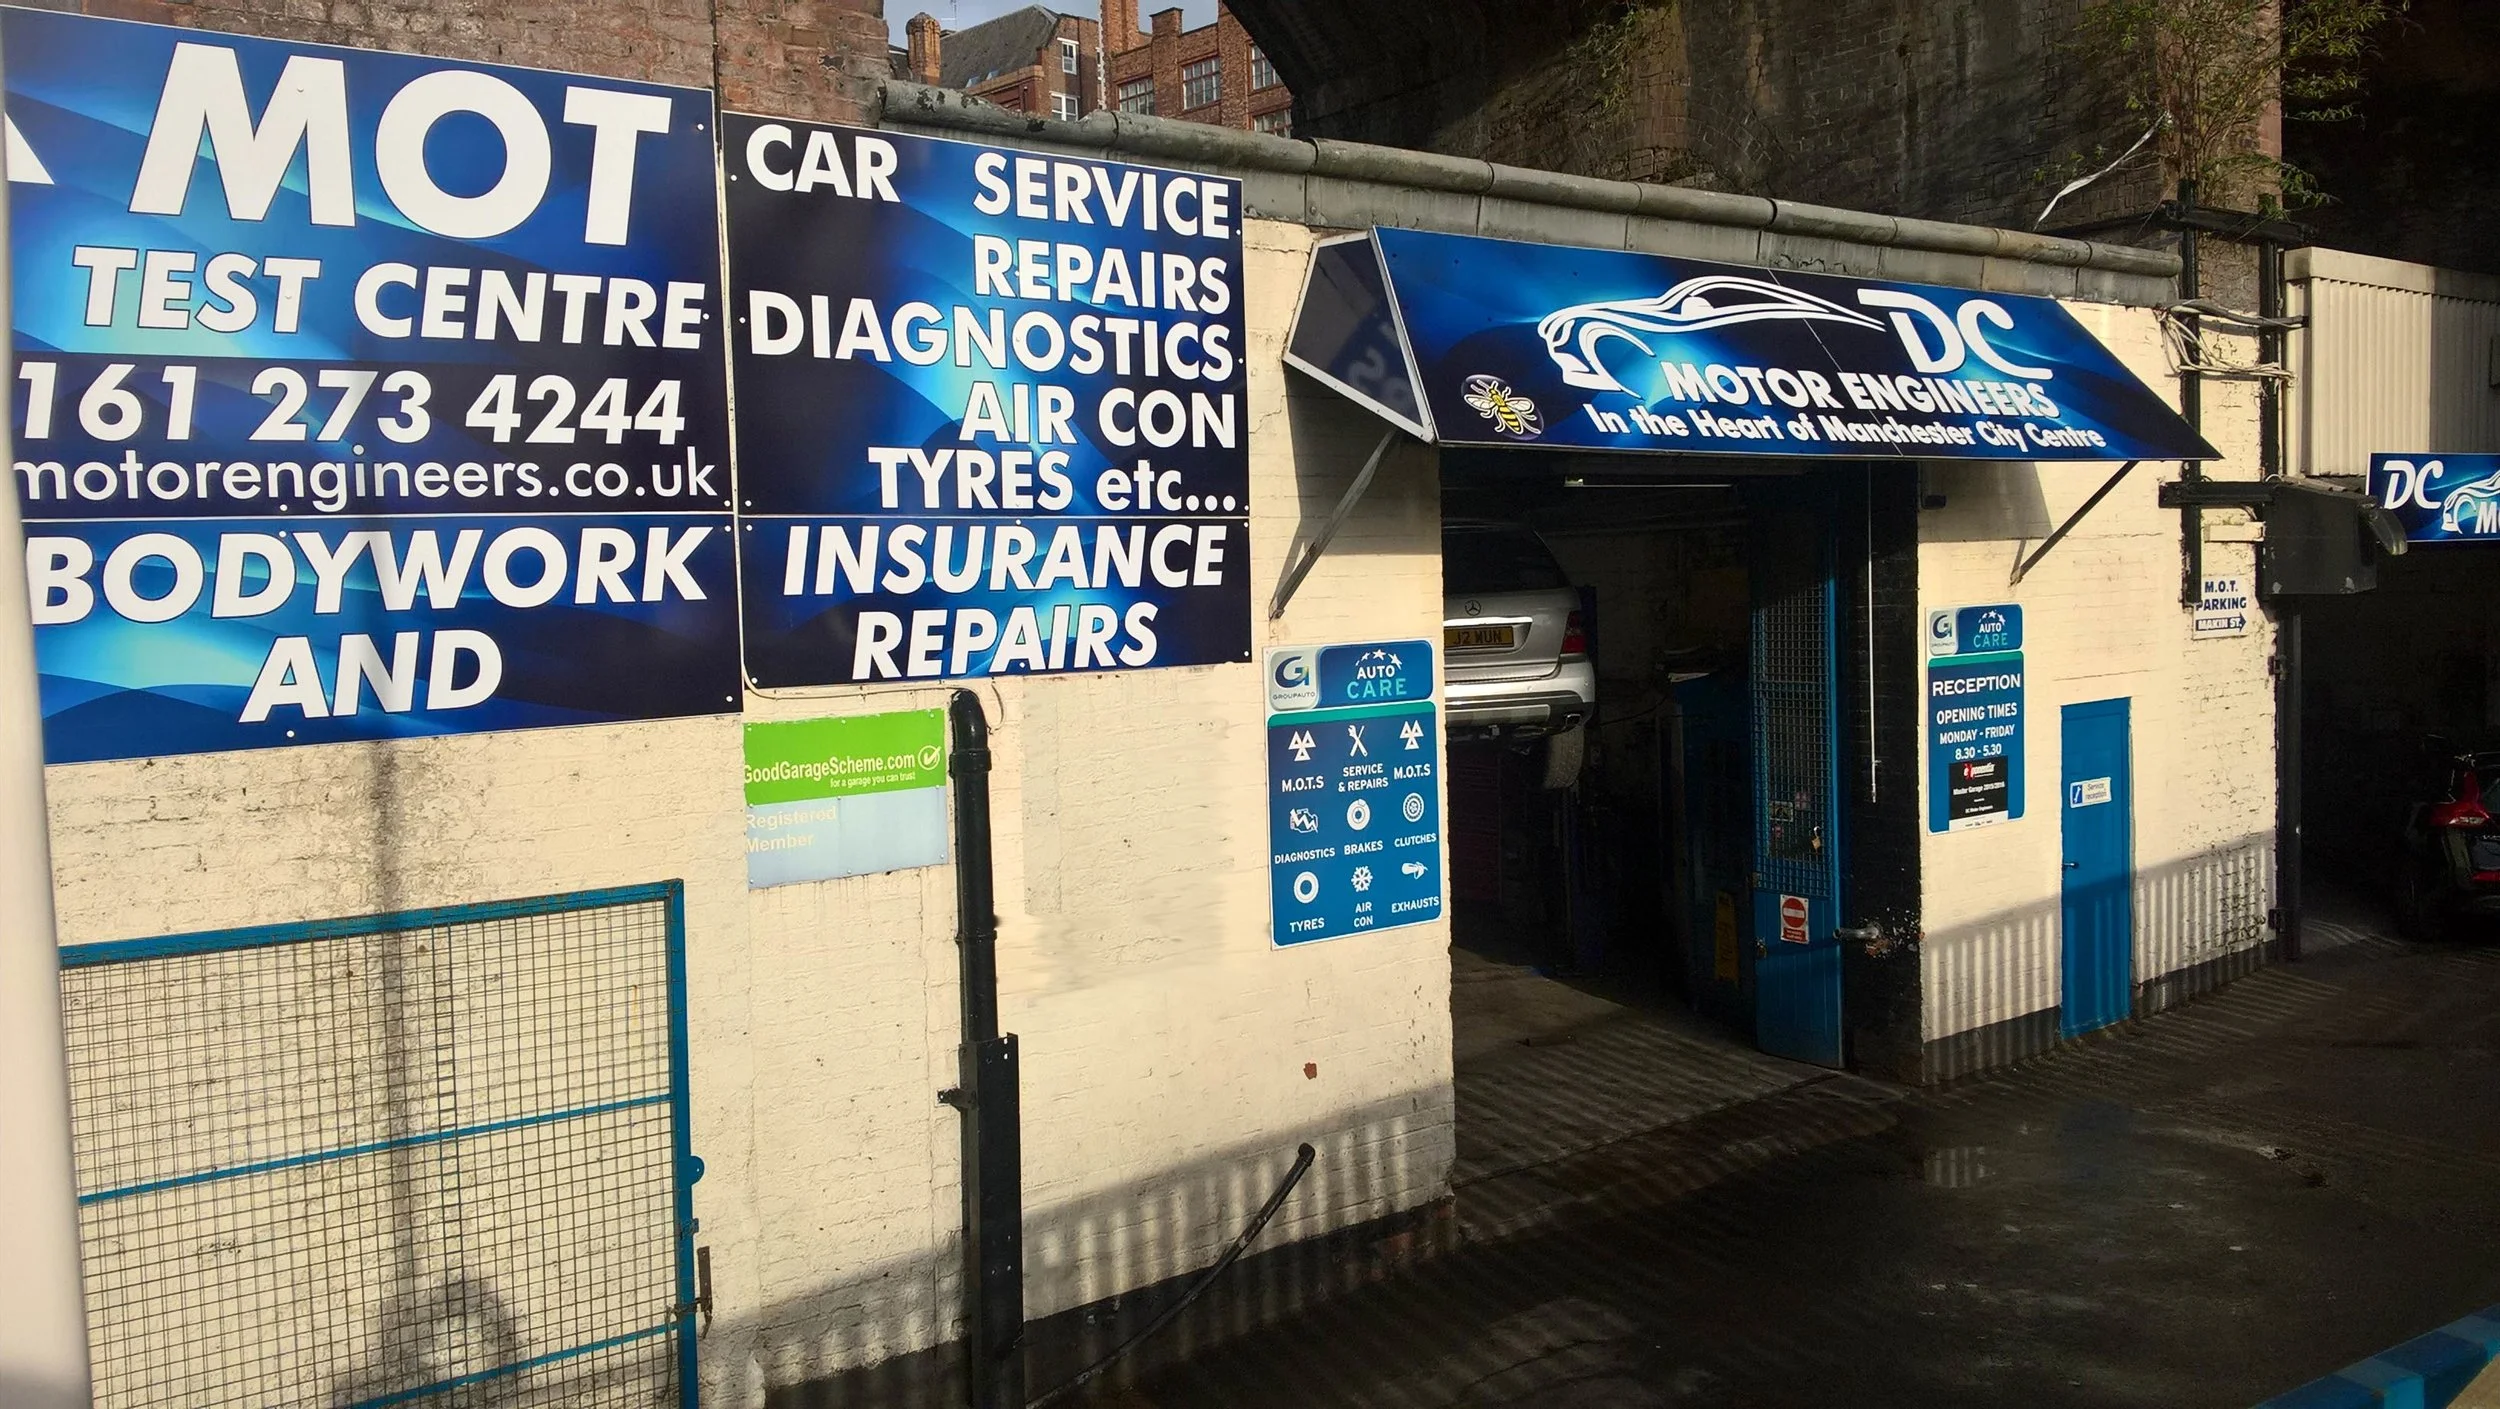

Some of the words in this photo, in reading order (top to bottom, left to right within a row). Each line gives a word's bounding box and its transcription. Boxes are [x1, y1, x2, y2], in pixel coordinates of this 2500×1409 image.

[128, 41, 672, 246] MOT
[746, 124, 900, 202] CAR
[973, 152, 1229, 240] SERVICE
[973, 233, 1230, 315] REPAIRS
[73, 245, 321, 334] TEST
[354, 262, 706, 349] CENTRE
[749, 289, 1233, 381] DIAGNOSTICS
[1858, 288, 2053, 380] DC
[1660, 360, 1843, 410] MOTOR
[1840, 372, 2060, 418] ENGINEERS
[249, 368, 432, 444] 273
[465, 373, 686, 445] 4244
[958, 381, 1077, 445] AIR
[1098, 386, 1236, 449] CON
[1583, 403, 1630, 434] In
[1628, 405, 1689, 437] the
[1686, 409, 1784, 440] Heart
[1786, 413, 1821, 441] of
[1820, 415, 1977, 446] Manchester
[1975, 420, 2029, 452] City
[2023, 423, 2107, 448] Centre
[13, 447, 719, 512] motorengineers.co.uk
[868, 446, 1073, 510] TYRES
[1096, 459, 1237, 512] etc...
[2383, 460, 2444, 510] DC
[2475, 501, 2500, 534] M
[783, 524, 1227, 596] INSURANCE
[26, 526, 714, 626] BODYWORK
[2205, 580, 2238, 593] M.O.T.
[2196, 597, 2247, 611] PARKING
[1979, 622, 2002, 633] AUTO
[852, 601, 1158, 681] REPAIRS
[1973, 633, 2008, 648] CARE
[238, 629, 502, 725] AND
[1356, 665, 1395, 679] AUTO
[1347, 678, 1407, 699] CARE
[1932, 674, 2021, 696] RECEPTION
[1936, 706, 1985, 724] OPENING
[1987, 702, 2017, 718] TIMES
[1940, 729, 1977, 744] MONDAY
[1985, 724, 2015, 738] FRIDAY
[1955, 747, 1976, 760] 8.30
[1983, 743, 2002, 756] 5.30
[744, 753, 915, 783] GoodGarageScheme.com
[1343, 763, 1383, 777] SERVICE
[1393, 764, 1430, 779] M.O.T.S
[830, 777, 840, 788] for
[848, 776, 871, 788] garage
[872, 775, 886, 785] you
[886, 774, 899, 783] can
[899, 772, 915, 781] trust
[1282, 775, 1324, 792] M.O.T.S
[1338, 781, 1346, 792] &
[1347, 777, 1388, 790] REPAIRS
[746, 806, 836, 830] Registered
[747, 833, 815, 854] Member
[1344, 840, 1383, 855] BRAKES
[1394, 833, 1436, 847] CLUTCHES
[1274, 847, 1335, 864] DIAGNOSTICS
[1355, 902, 1372, 913] AIR
[1391, 896, 1440, 913] EXHAUSTS
[1290, 917, 1325, 933] TYRES
[1354, 916, 1373, 928] CON
